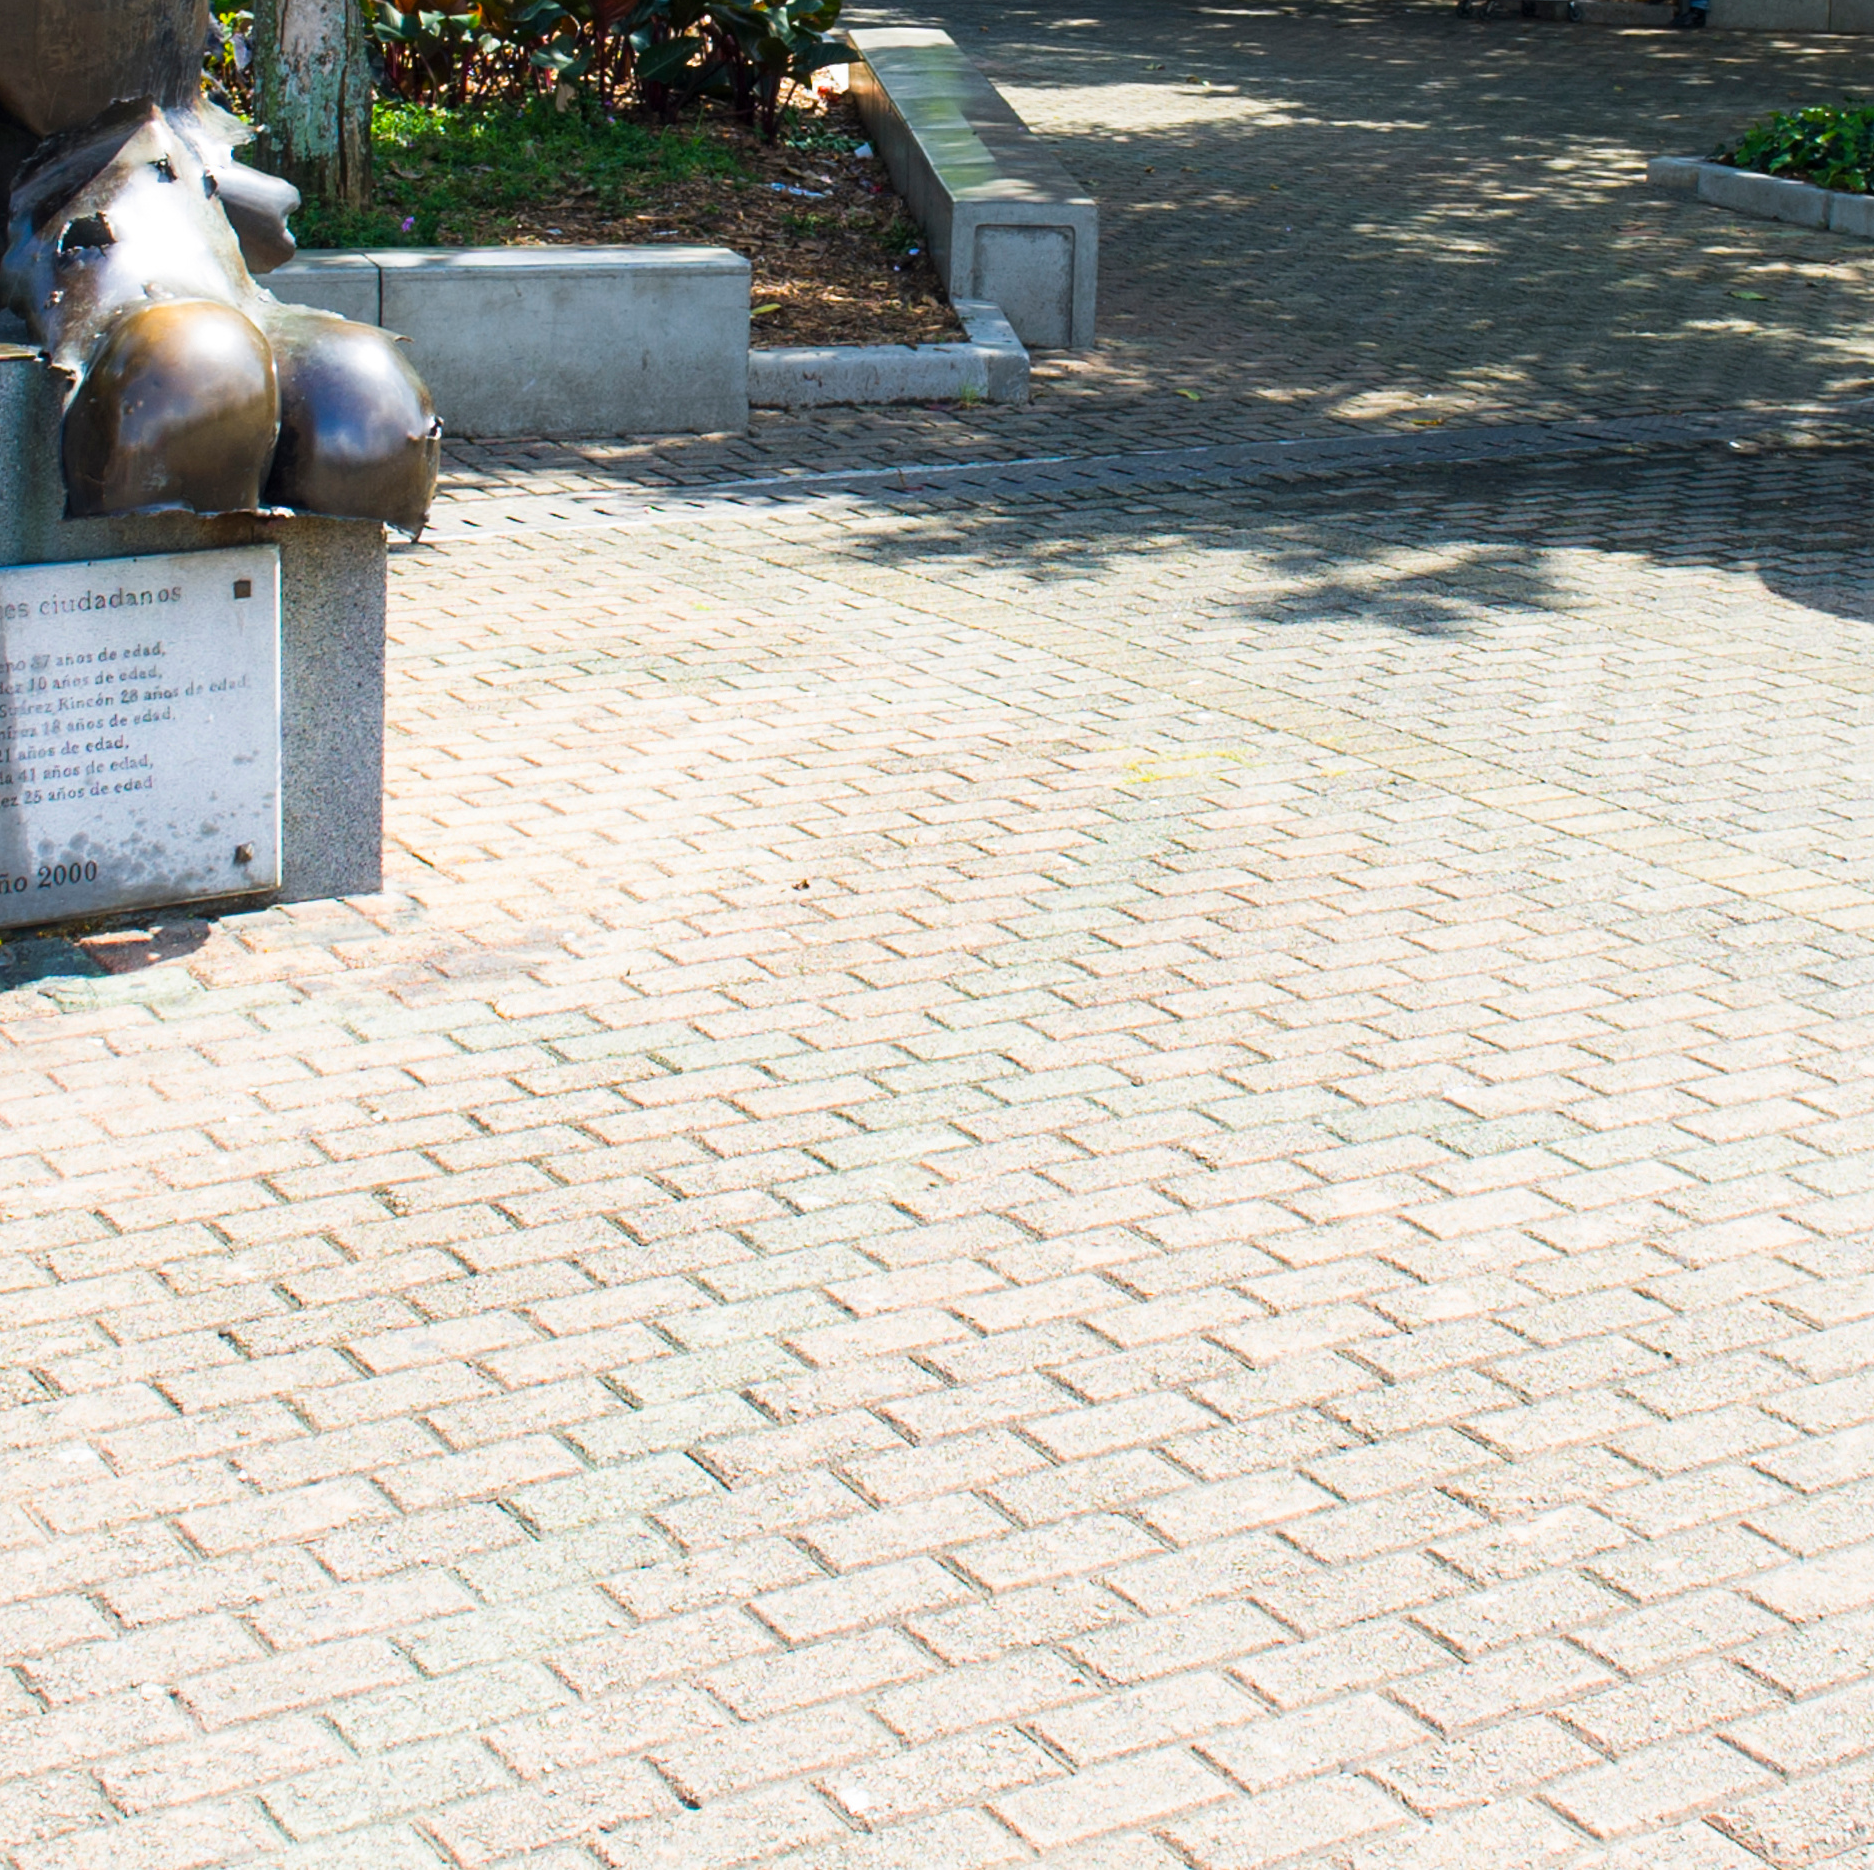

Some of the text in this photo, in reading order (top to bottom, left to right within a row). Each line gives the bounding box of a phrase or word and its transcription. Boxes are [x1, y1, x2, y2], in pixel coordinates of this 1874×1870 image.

[38, 585, 182, 615] ciudadanos
[54, 652, 93, 666] años
[97, 646, 117, 662] de
[93, 670, 114, 685] de
[143, 684, 179, 701] años
[184, 680, 204, 696] de
[66, 717, 104, 732] años
[108, 712, 128, 727] de
[17, 745, 56, 761] años
[59, 740, 80, 755] de
[42, 764, 80, 780] años
[84, 759, 105, 775] de
[109, 752, 154, 772] edad,
[47, 786, 85, 802] años
[89, 780, 109, 796] de
[113, 774, 153, 793] edad
[36, 859, 97, 889] 2000
